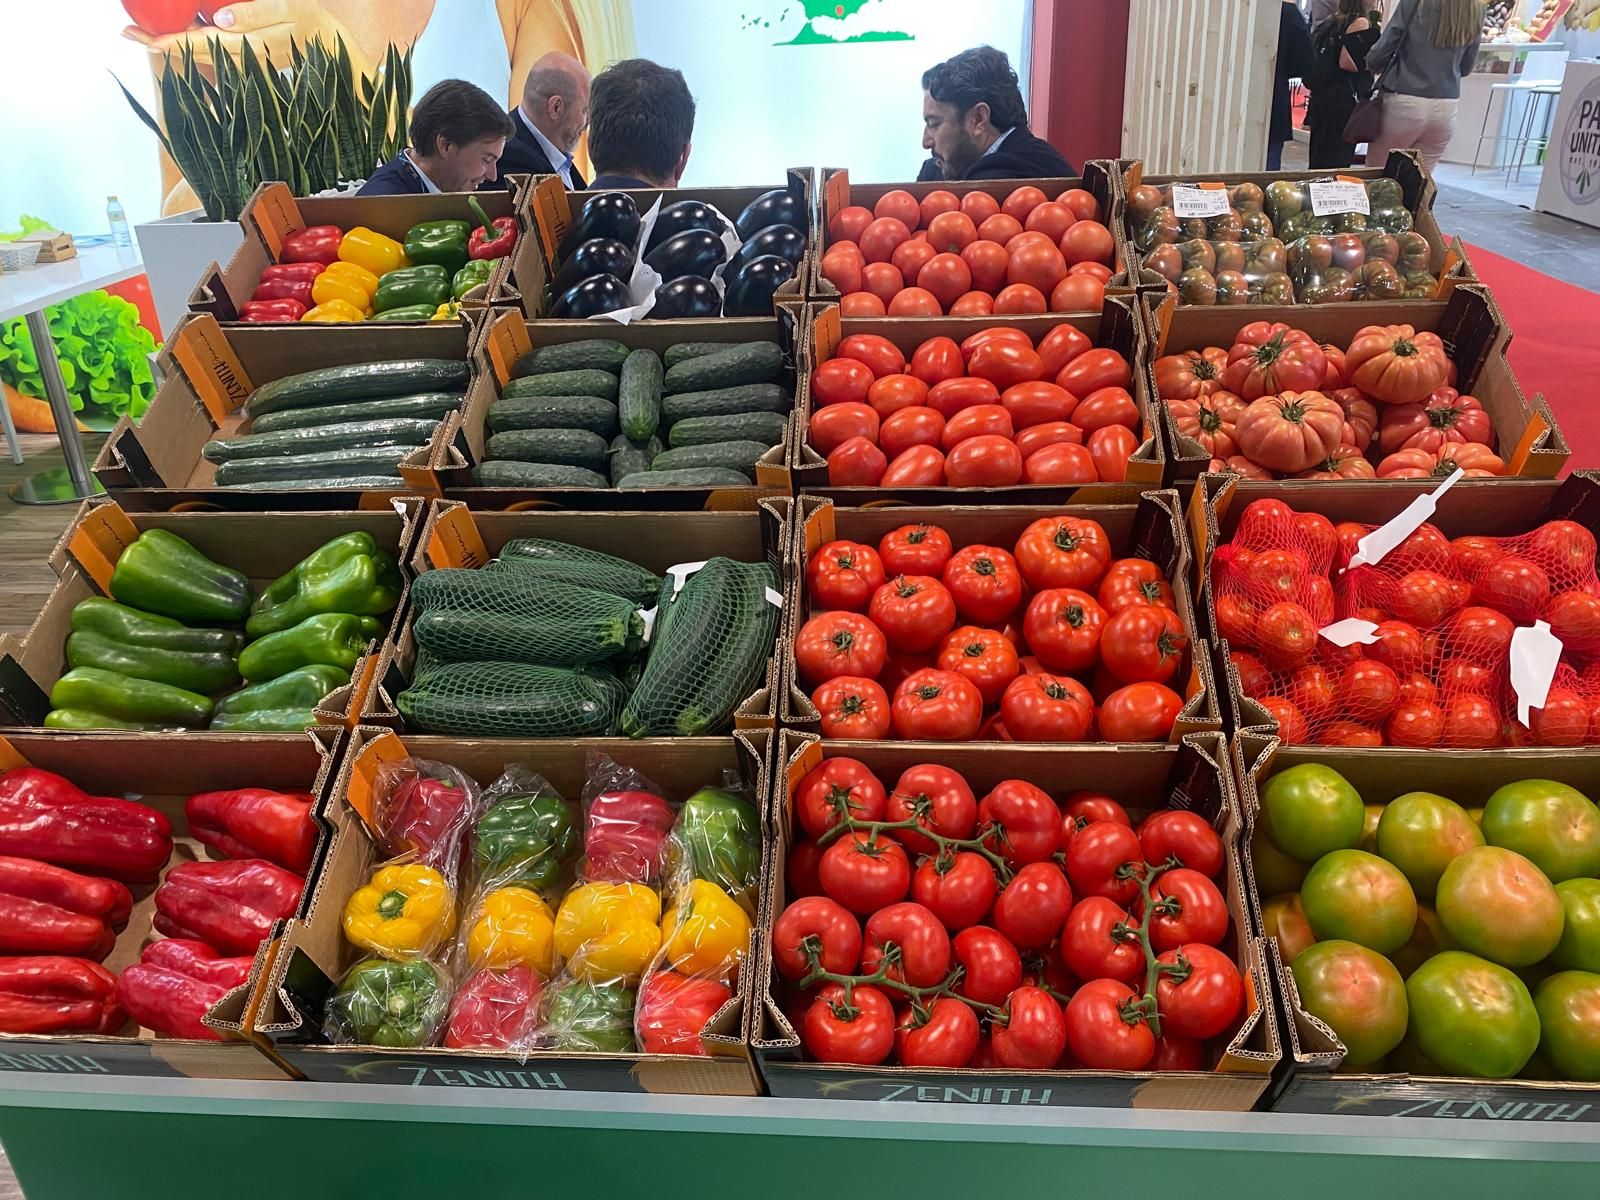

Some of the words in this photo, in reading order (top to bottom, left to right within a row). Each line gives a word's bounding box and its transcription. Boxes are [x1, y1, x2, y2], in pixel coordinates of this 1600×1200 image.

[214, 361, 249, 404] ZENITH
[398, 1066, 567, 1089] ZENITH
[880, 1084, 1052, 1104] ZENITH
[1390, 1099, 1592, 1121] ZENITH
